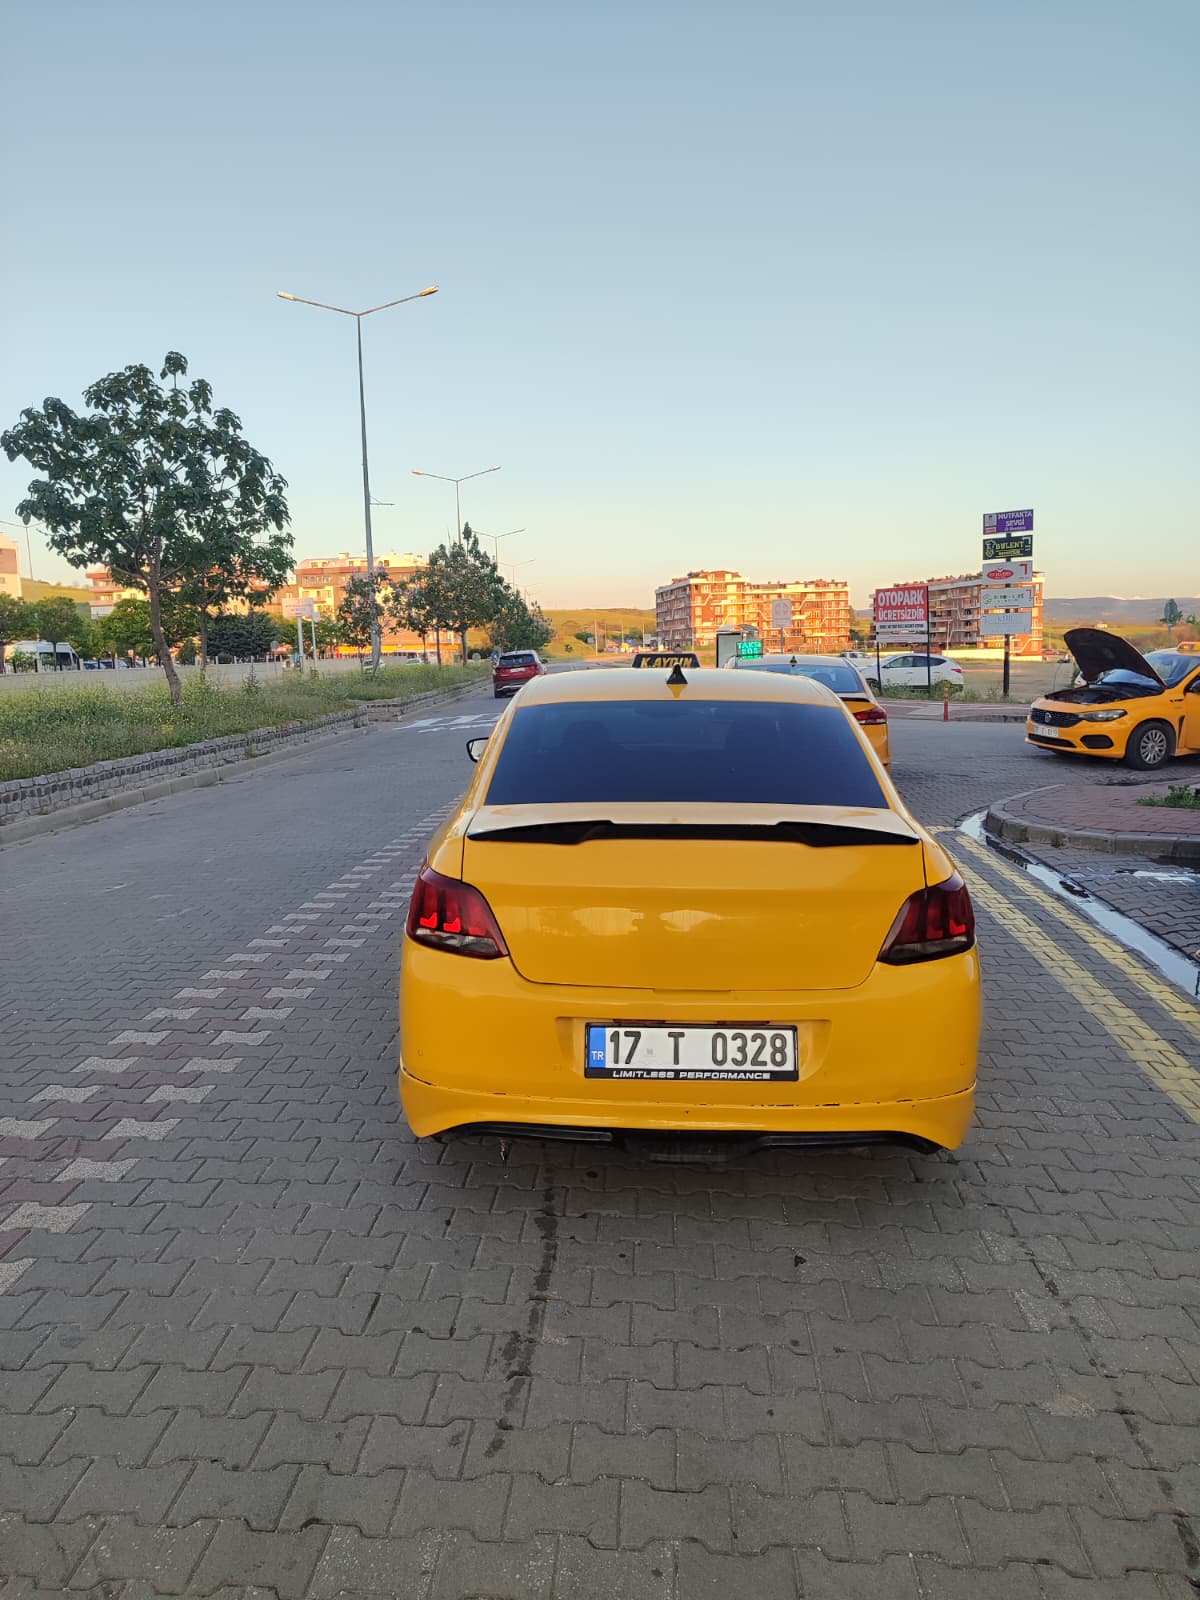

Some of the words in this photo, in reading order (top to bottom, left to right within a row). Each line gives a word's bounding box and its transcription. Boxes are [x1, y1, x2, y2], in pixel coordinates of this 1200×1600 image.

[878, 590, 924, 606] OTOPARK
[878, 606, 924, 620] ÜCRETSİZDİR
[592, 1050, 604, 1061] TR
[609, 1030, 642, 1065] 17
[667, 1031, 685, 1066] T
[711, 1031, 788, 1067] 0328
[612, 1070, 674, 1079] LIMITLESS
[679, 1071, 771, 1080] PERFORMANCE
